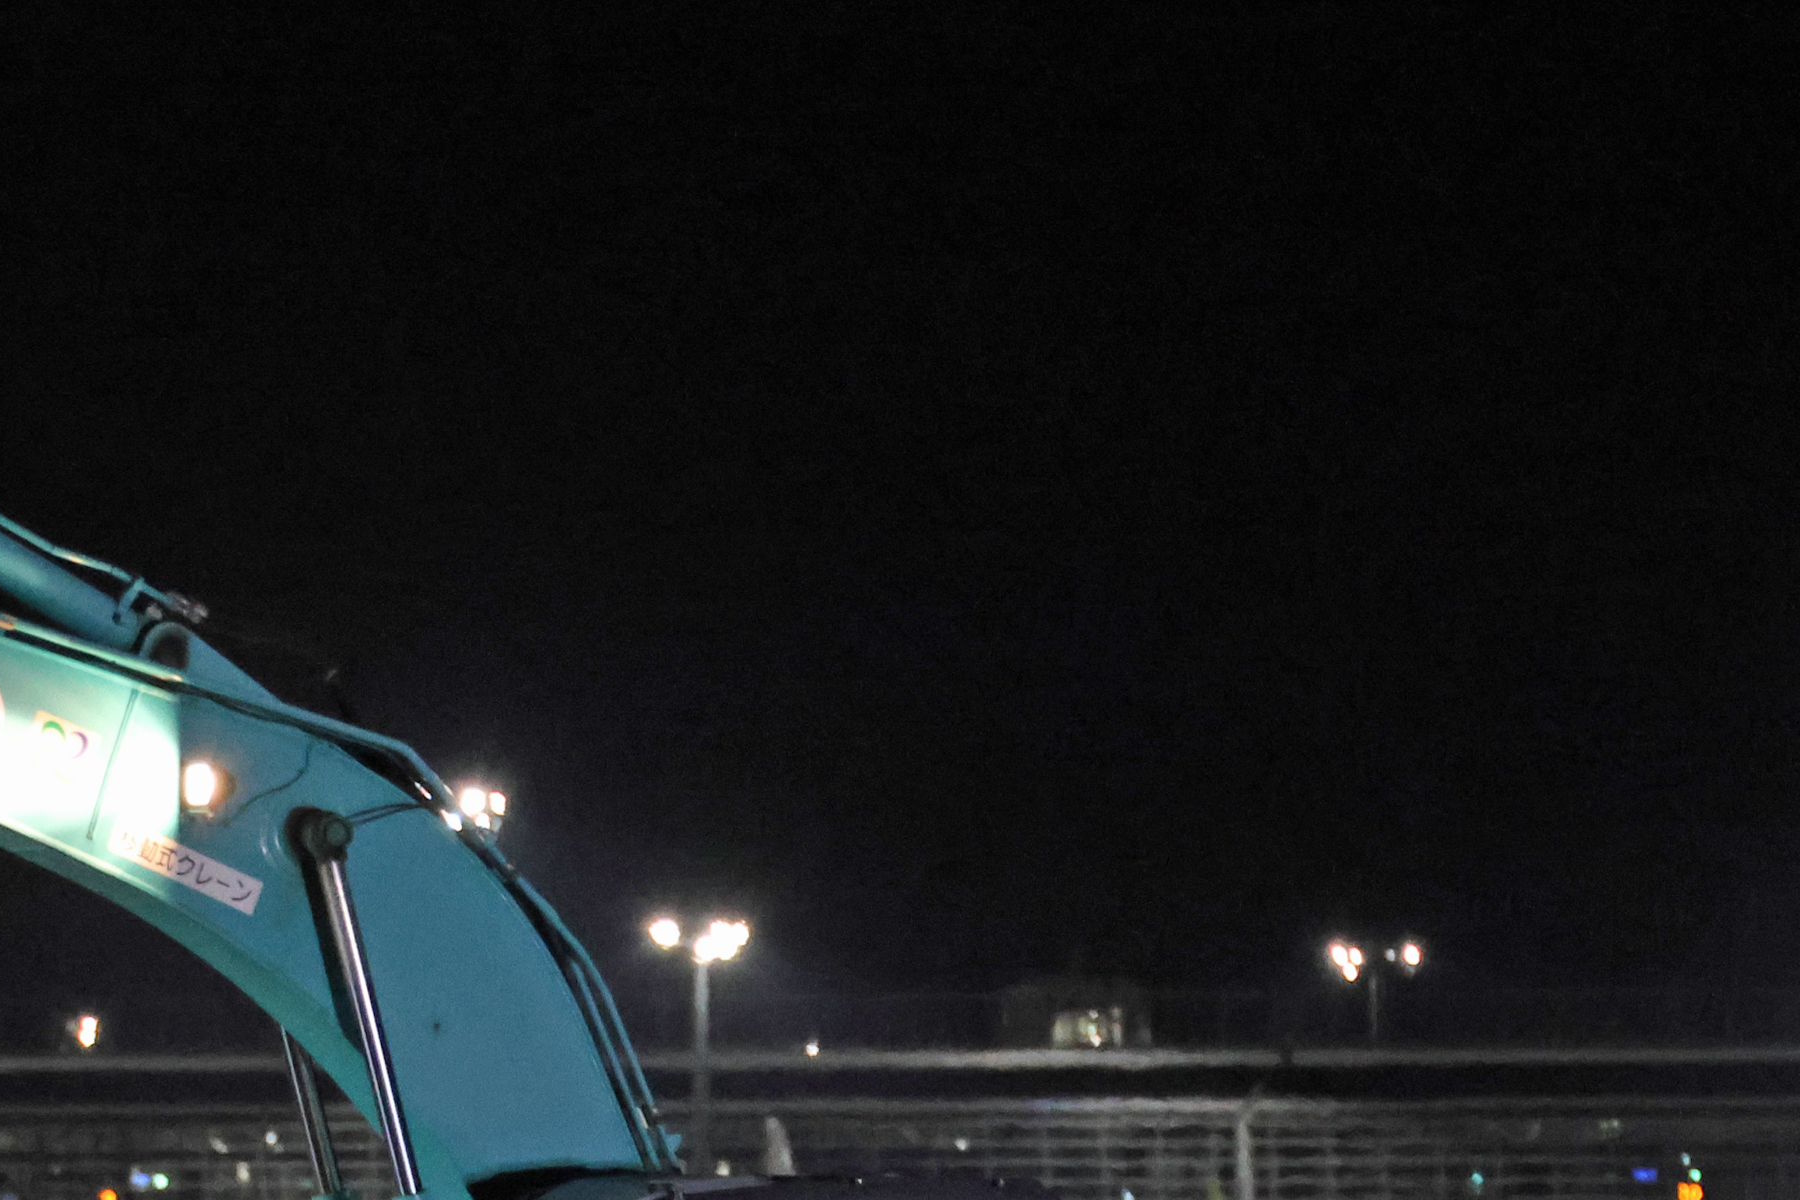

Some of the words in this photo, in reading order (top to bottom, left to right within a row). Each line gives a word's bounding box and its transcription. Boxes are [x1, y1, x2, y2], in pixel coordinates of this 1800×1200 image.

[121, 832, 253, 901] 動式クレーン
